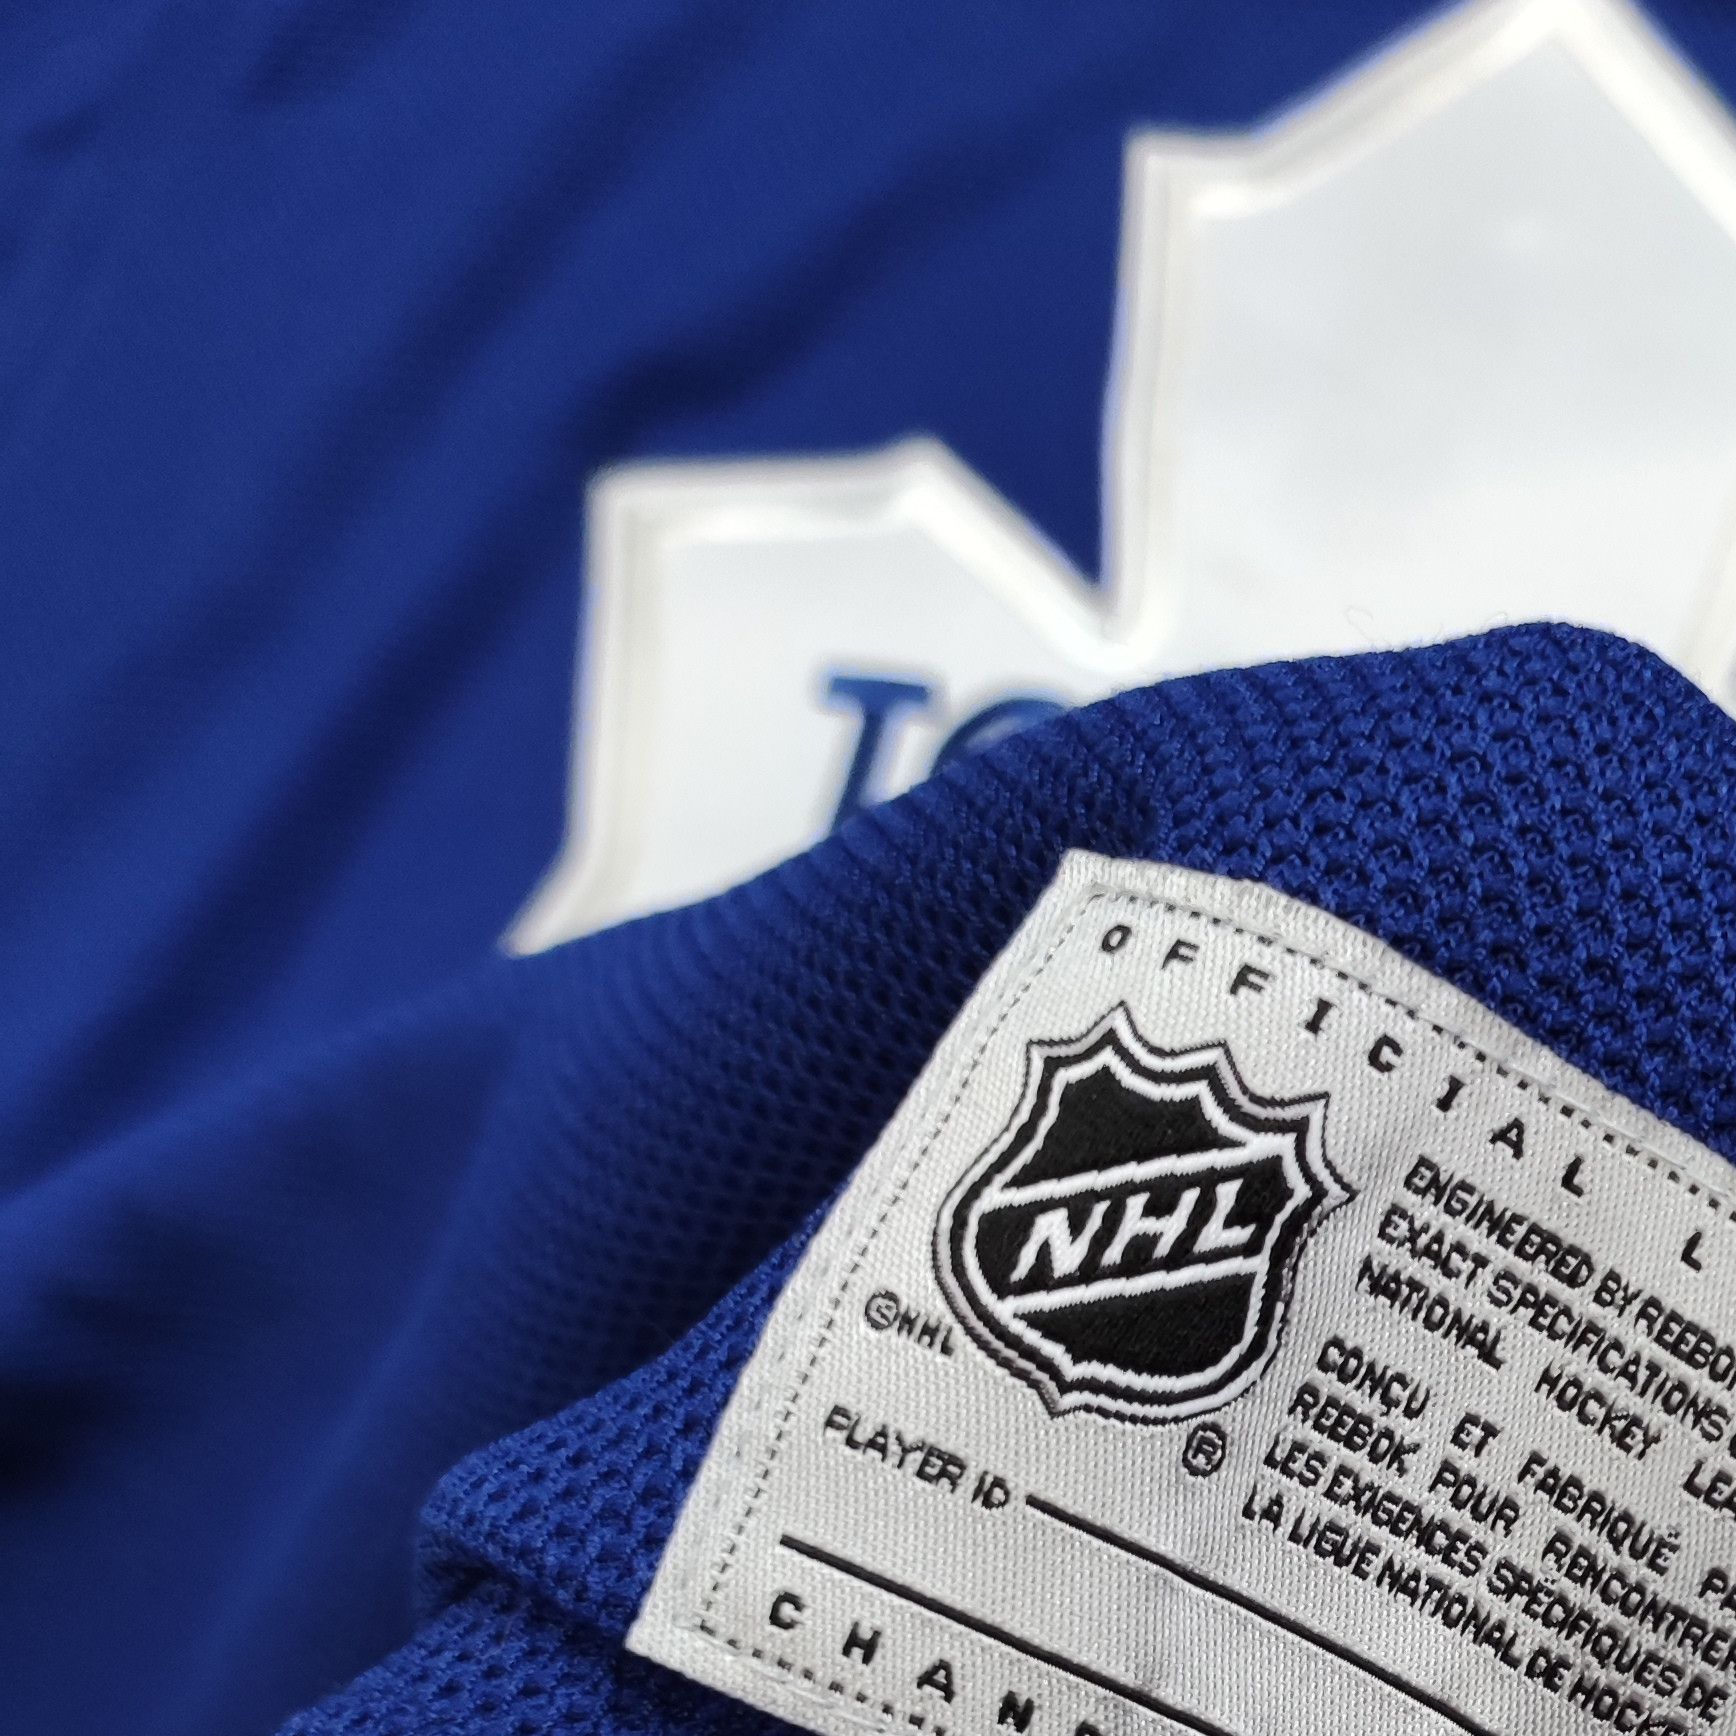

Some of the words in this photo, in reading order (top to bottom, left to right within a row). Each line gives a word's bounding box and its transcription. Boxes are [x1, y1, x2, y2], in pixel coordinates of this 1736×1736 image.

[1100, 923, 1584, 1198] OFFICIAL
[1010, 1180, 1262, 1284] NHL
[1378, 1204, 1491, 1290] EXACT
[1486, 1267, 1731, 1443] SPECIFICATIONS
[1403, 1153, 1594, 1290] ENGINEERED
[1592, 1271, 1642, 1319] BY
[823, 1404, 967, 1493] PLAYER
[972, 1471, 1011, 1511] ID
[1316, 1336, 1433, 1421] CONÇU
[1450, 1412, 1499, 1457] ET
[1518, 1451, 1681, 1576] FABRIQUÉ
[1355, 1254, 1506, 1370] NATIONAL
[1533, 1360, 1662, 1461] HOCKEY
[1288, 1383, 1420, 1475] REEBOK
[1429, 1459, 1521, 1538] POUR
[1241, 1492, 1286, 1538] LA
[1288, 1517, 1375, 1581] LIGUE
[1378, 1558, 1524, 1667] NATIONAL
[1524, 1647, 1570, 1694] DE
[1263, 1440, 1322, 1489] LES
[1329, 1466, 1488, 1578] EXIGENCES
[1678, 1673, 1731, 1724] DE
